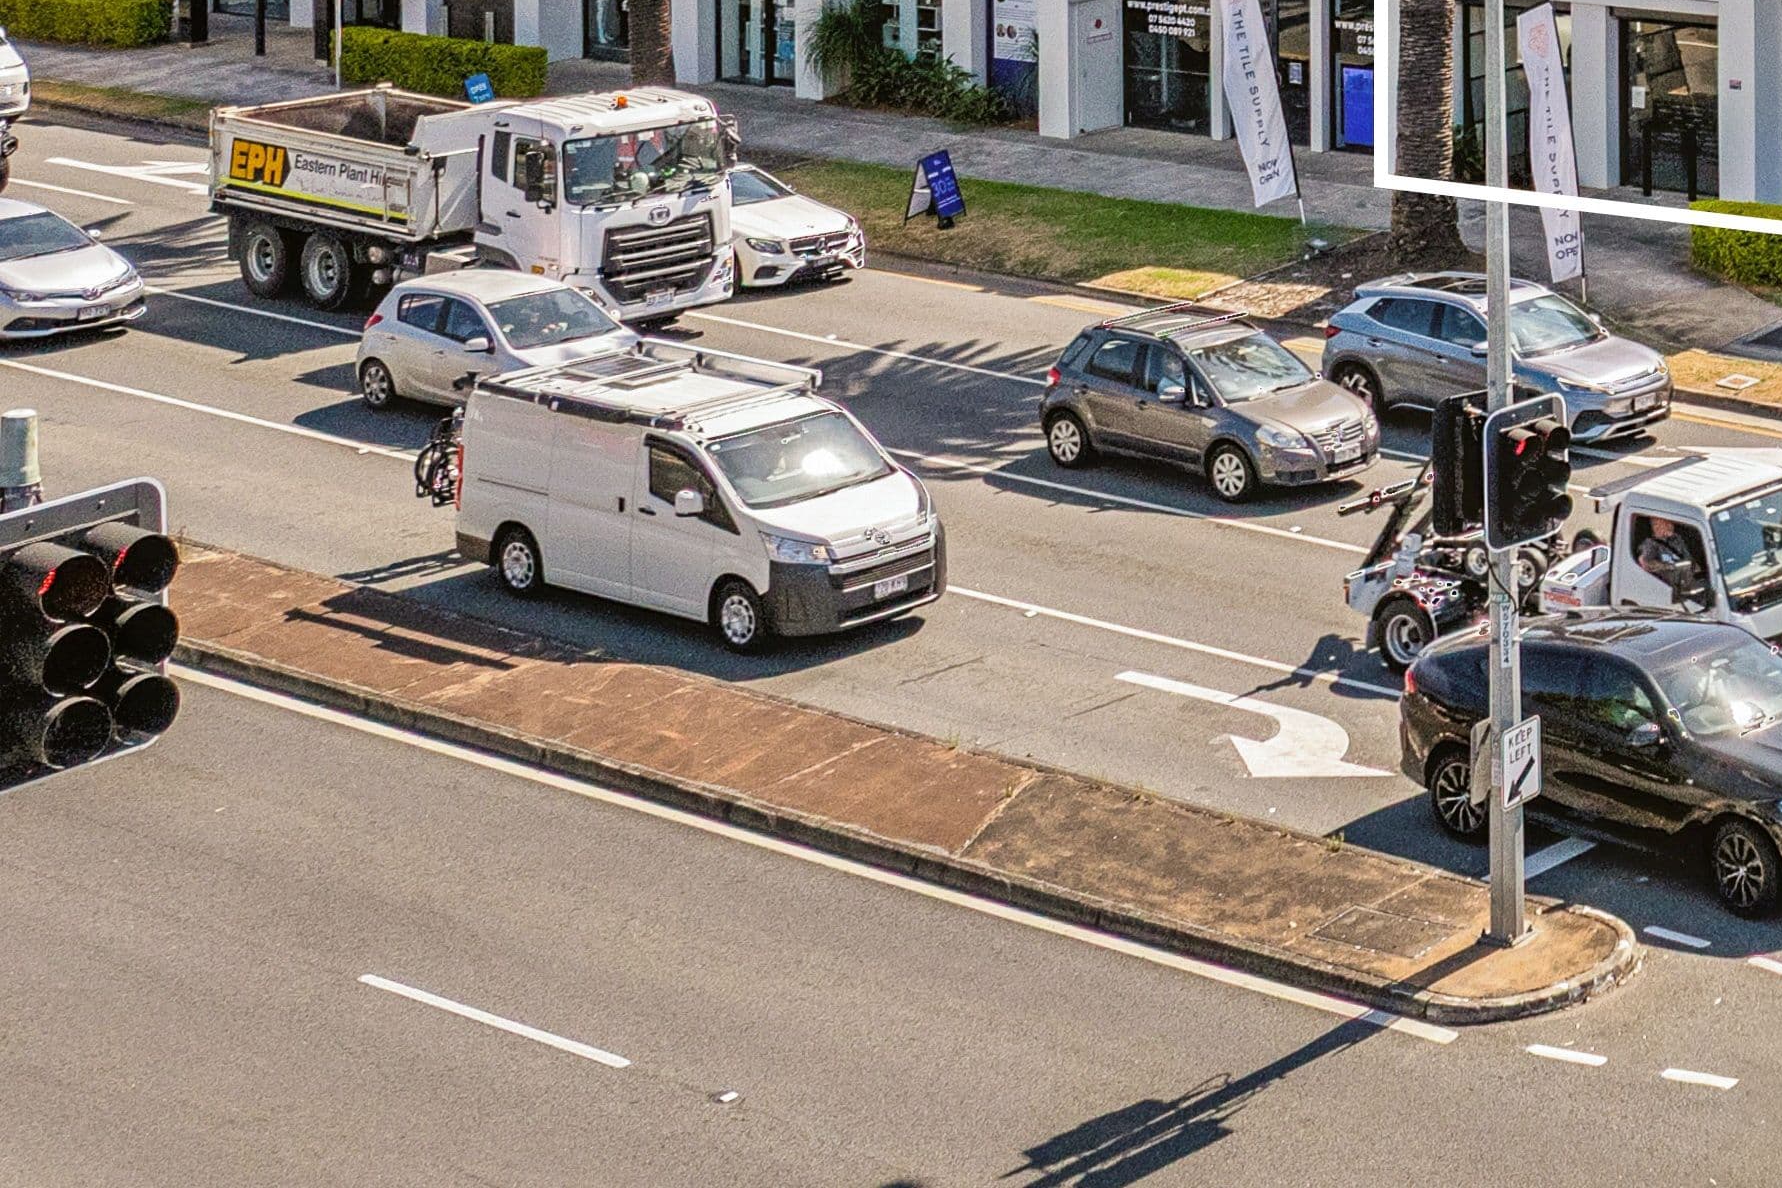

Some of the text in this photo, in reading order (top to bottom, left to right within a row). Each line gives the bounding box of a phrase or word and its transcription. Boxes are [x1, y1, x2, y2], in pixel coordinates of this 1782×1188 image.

[1232, 9, 1247, 41] THE
[1239, 45, 1256, 80] TILE
[1249, 85, 1271, 147] SUPPLY
[230, 139, 284, 186] EPH
[294, 154, 337, 177] Eastern
[338, 163, 369, 183] Plant
[1508, 726, 1532, 750] KEEP
[1509, 743, 1532, 764] LEFT
